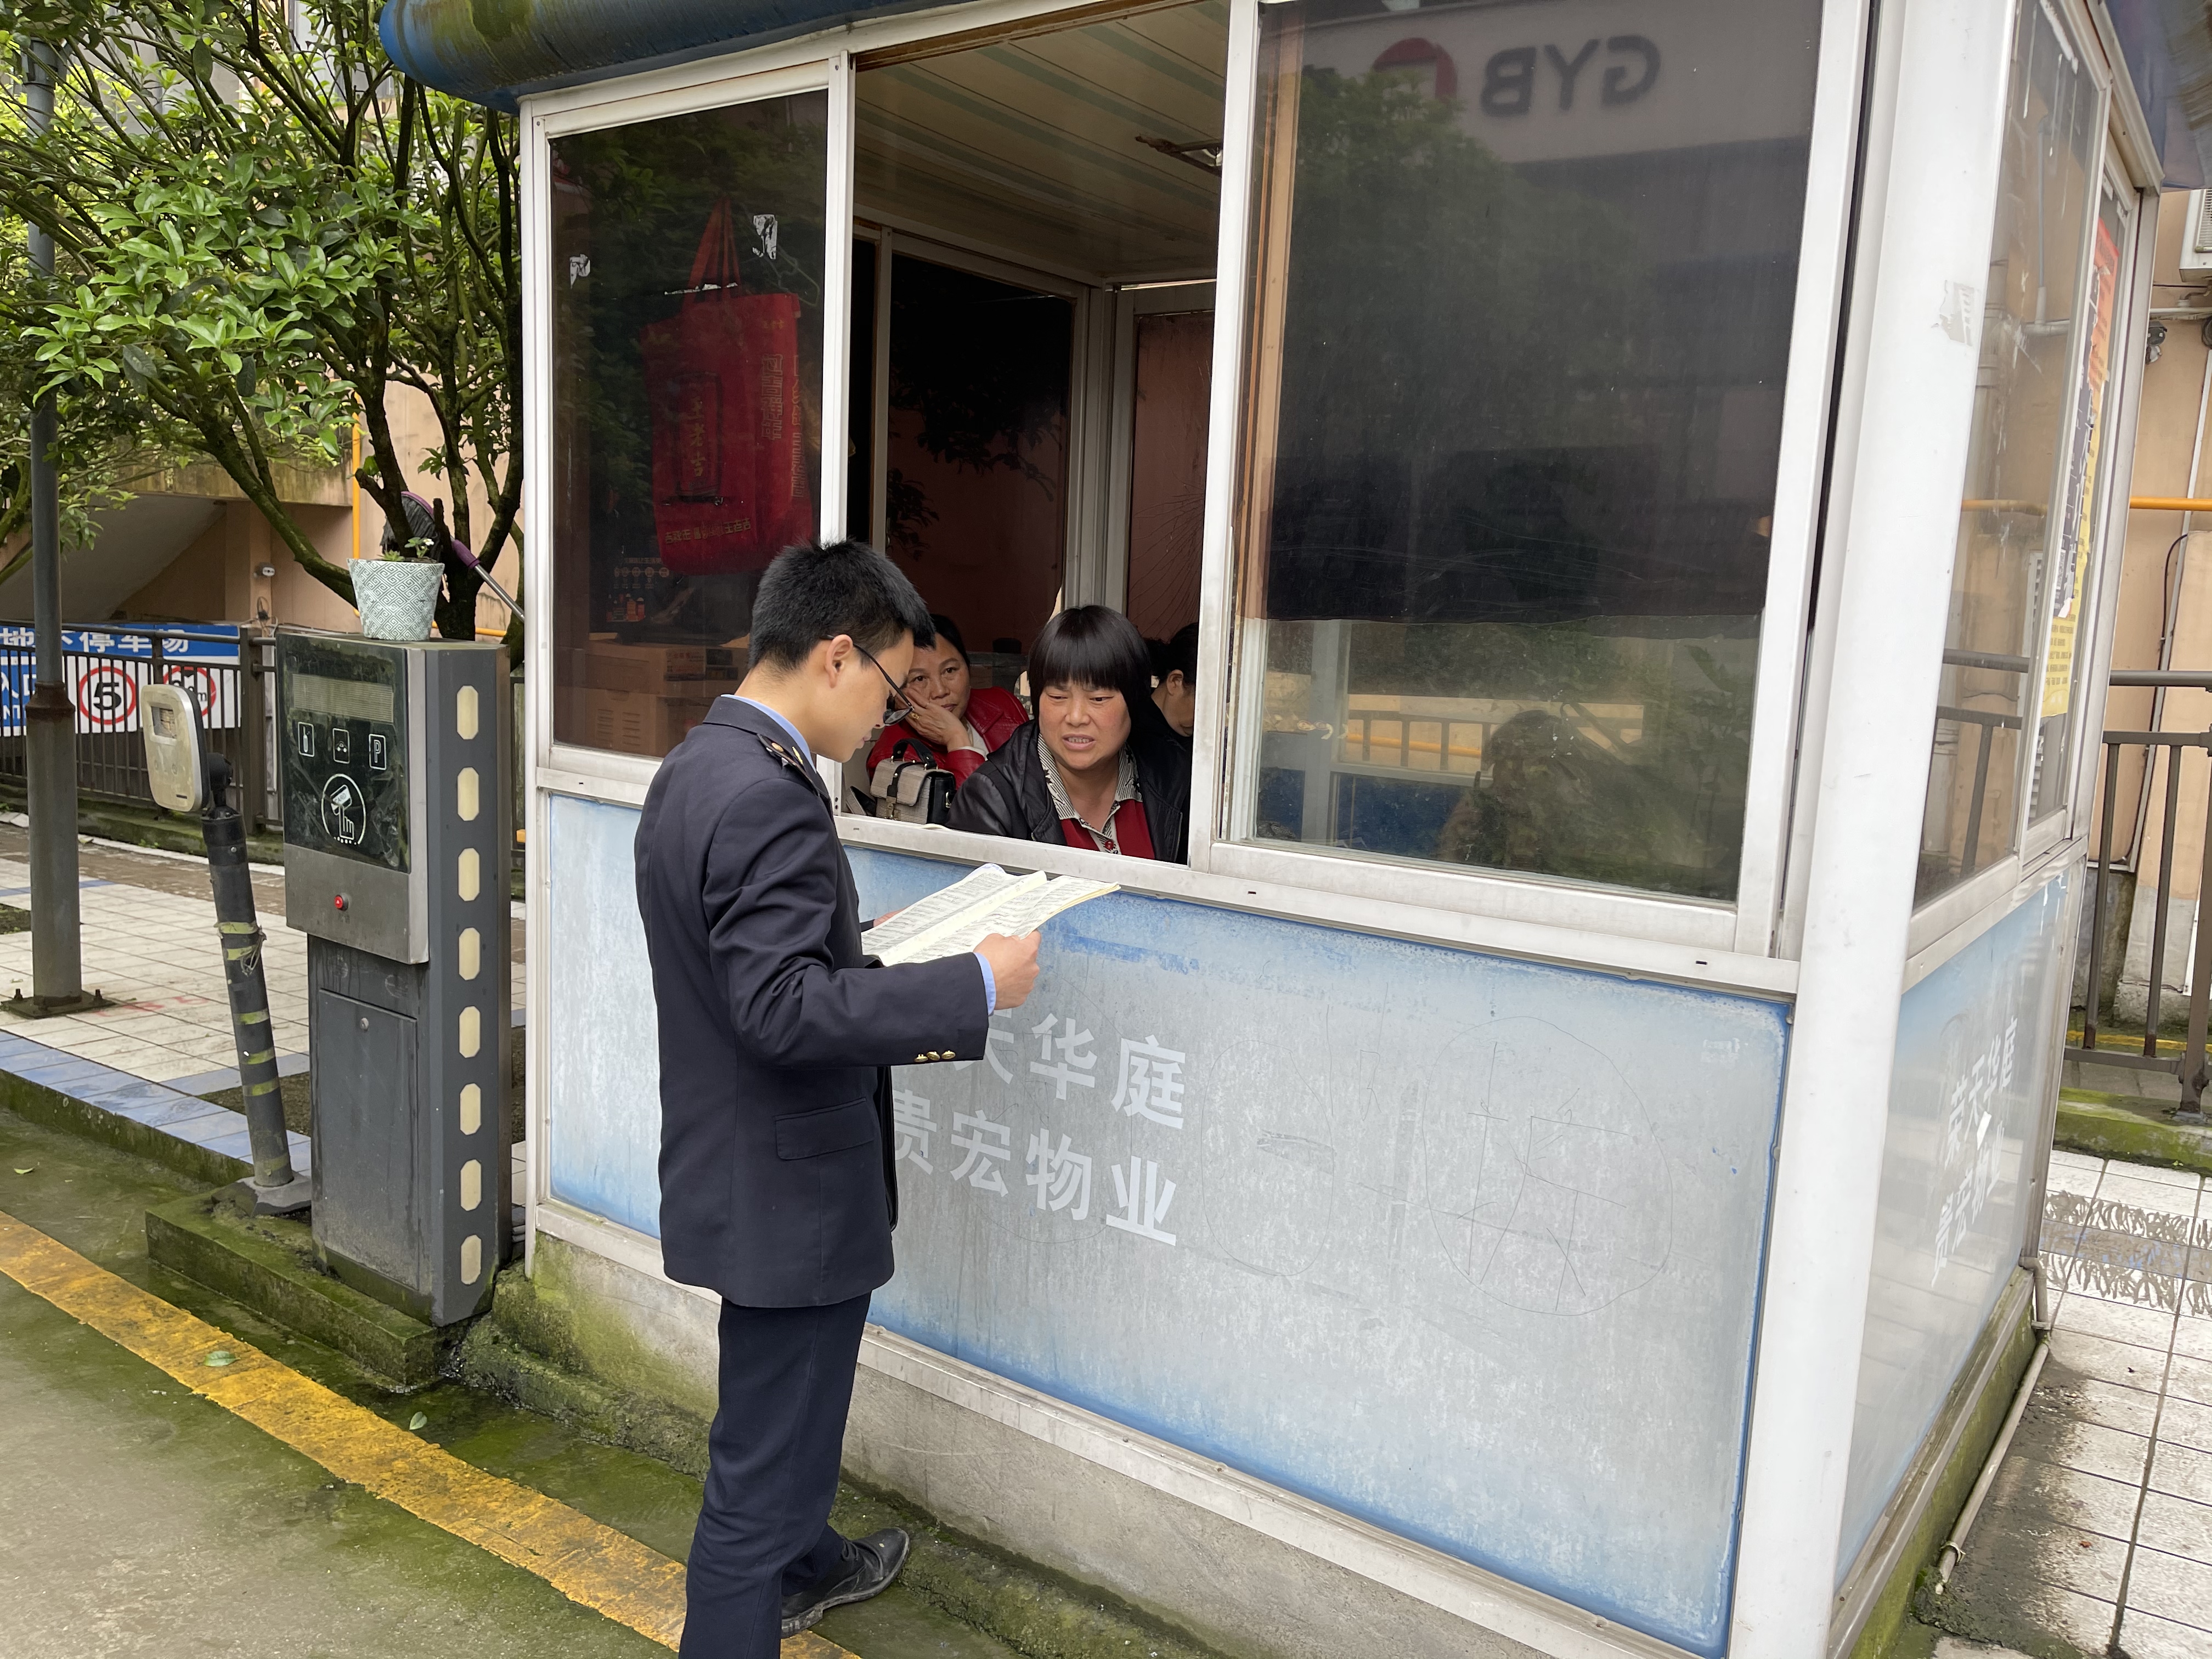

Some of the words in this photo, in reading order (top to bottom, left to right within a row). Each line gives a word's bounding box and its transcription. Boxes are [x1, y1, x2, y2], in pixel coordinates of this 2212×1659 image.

[93, 682, 122, 710] 5
[893, 1088, 1177, 1246] 贵宏物业
